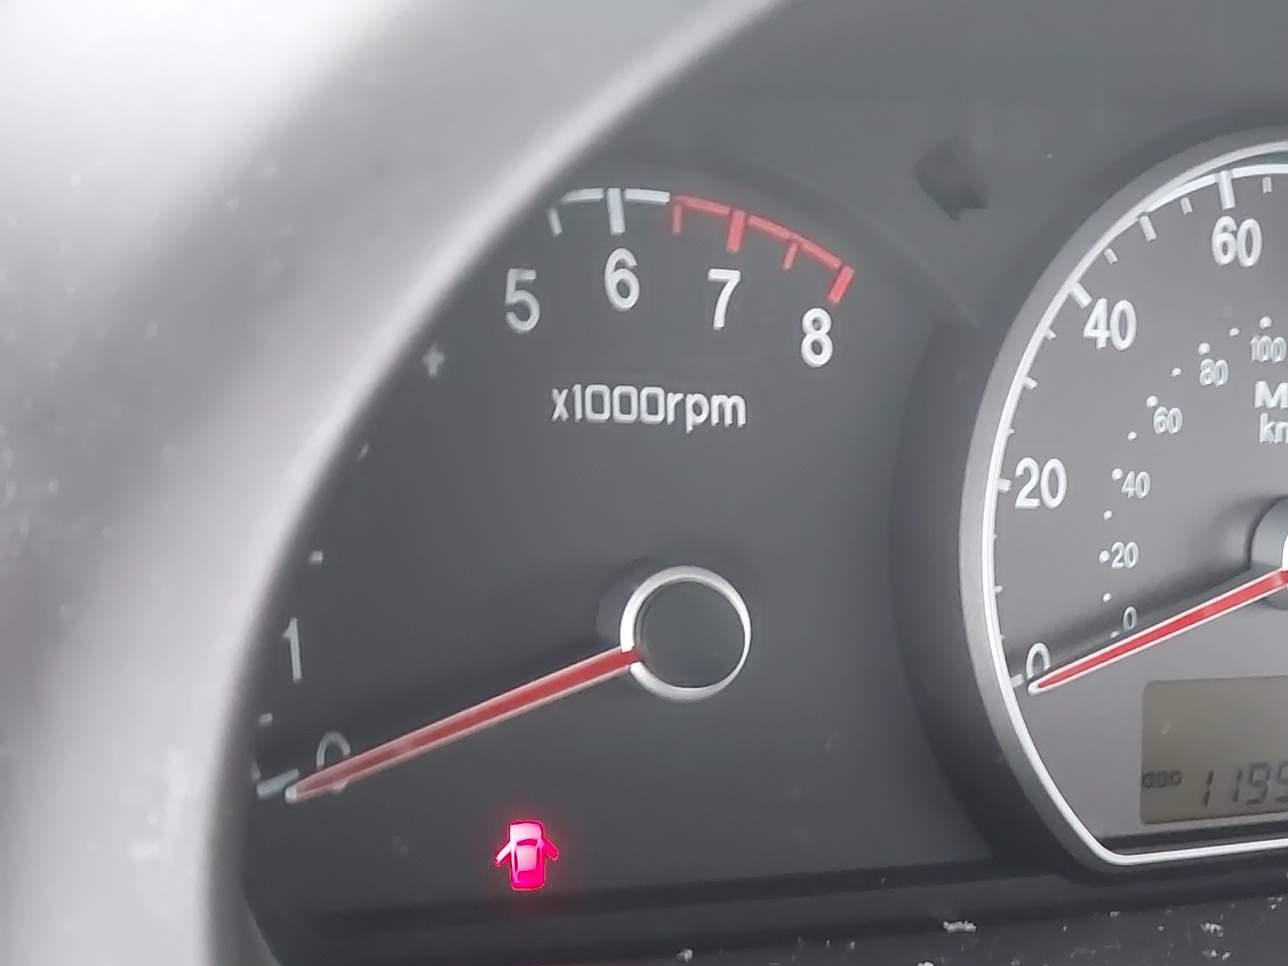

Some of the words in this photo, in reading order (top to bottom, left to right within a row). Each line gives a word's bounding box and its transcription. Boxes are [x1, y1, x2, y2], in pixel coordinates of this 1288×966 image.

[1211, 216, 1262, 267] 60
[504, 268, 541, 332] 5
[604, 248, 640, 310] 6
[708, 268, 741, 329] 7
[802, 307, 833, 367] 8
[1083, 298, 1137, 351] 40
[1249, 336, 1287, 363] 100
[550, 382, 747, 433] x1000rpm
[1153, 408, 1183, 435] 60
[1014, 457, 1067, 510] 20
[1121, 472, 1151, 499] 40
[1110, 541, 1139, 569] 20
[1123, 606, 1138, 632] 0
[283, 617, 302, 683] 1
